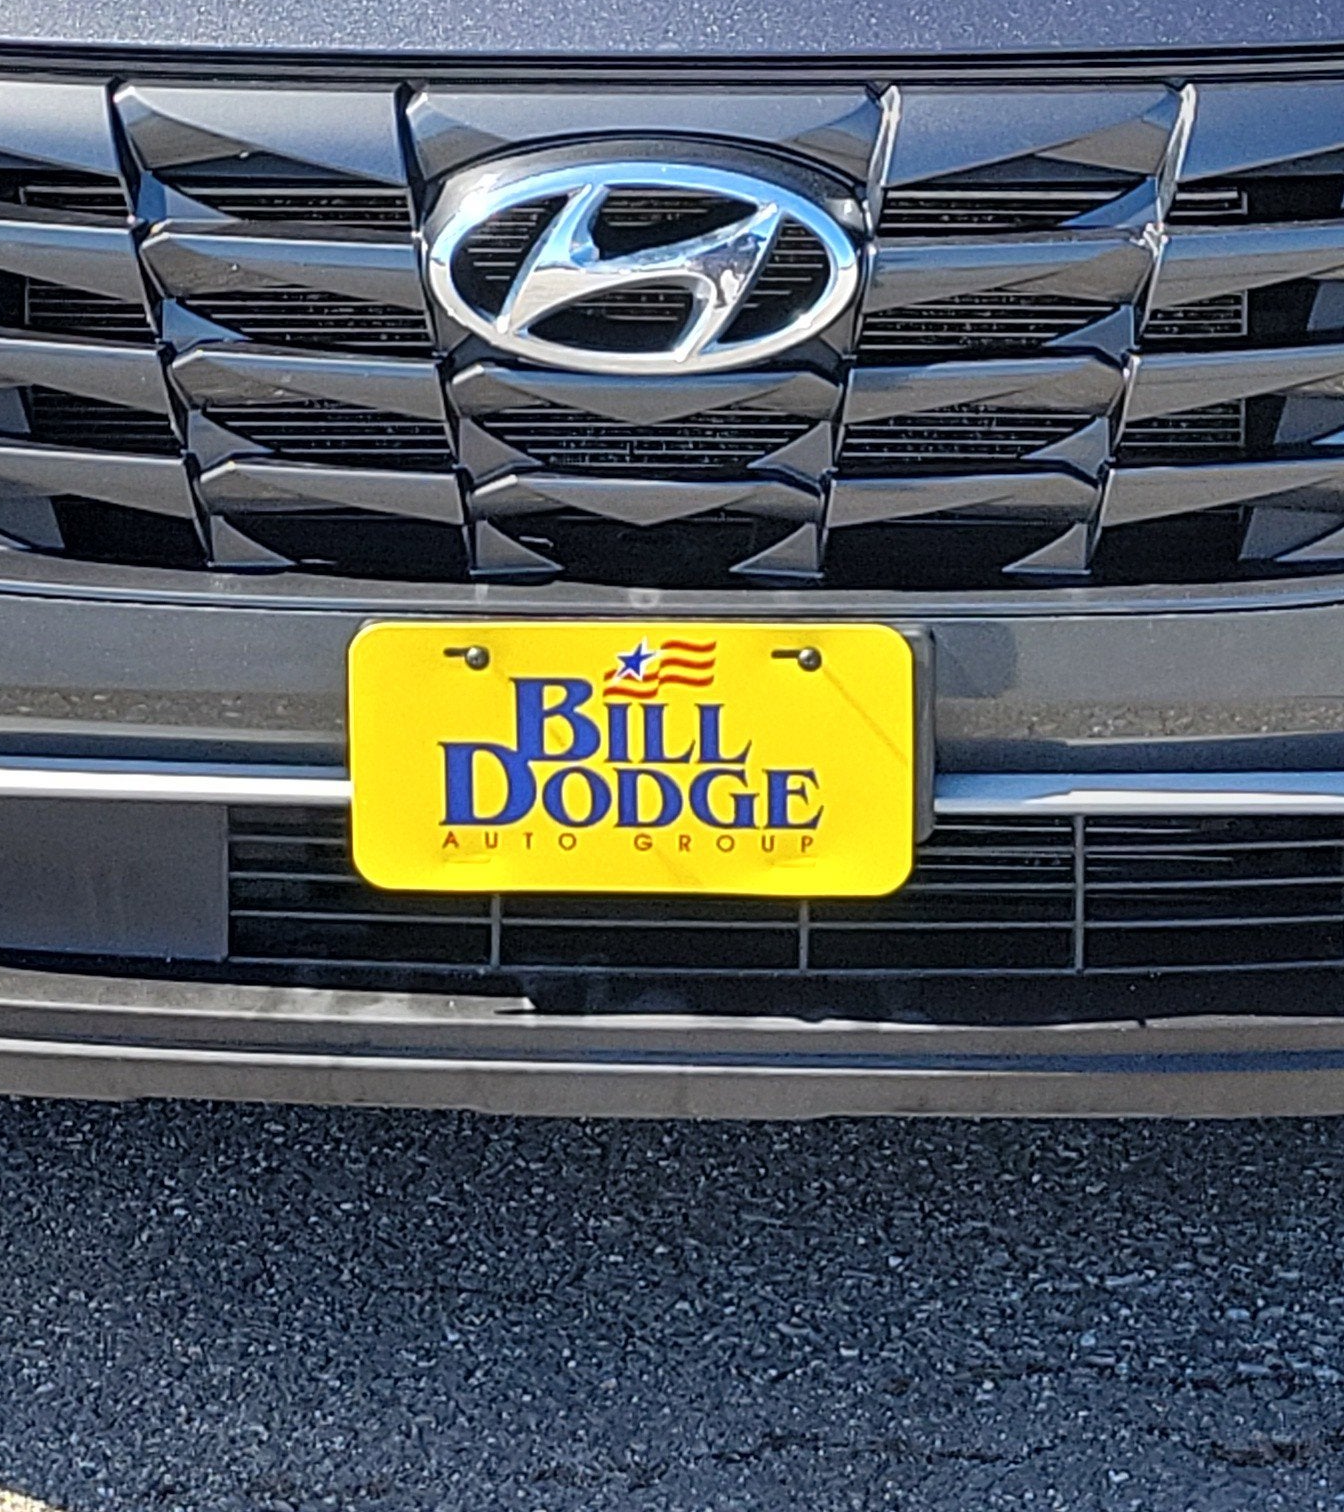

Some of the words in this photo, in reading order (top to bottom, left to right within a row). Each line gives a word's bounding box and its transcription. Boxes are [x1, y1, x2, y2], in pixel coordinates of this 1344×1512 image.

[509, 677, 752, 764] BILL
[438, 741, 824, 831] DODGE
[442, 830, 578, 852] AUTO
[633, 833, 815, 855] GROUP
